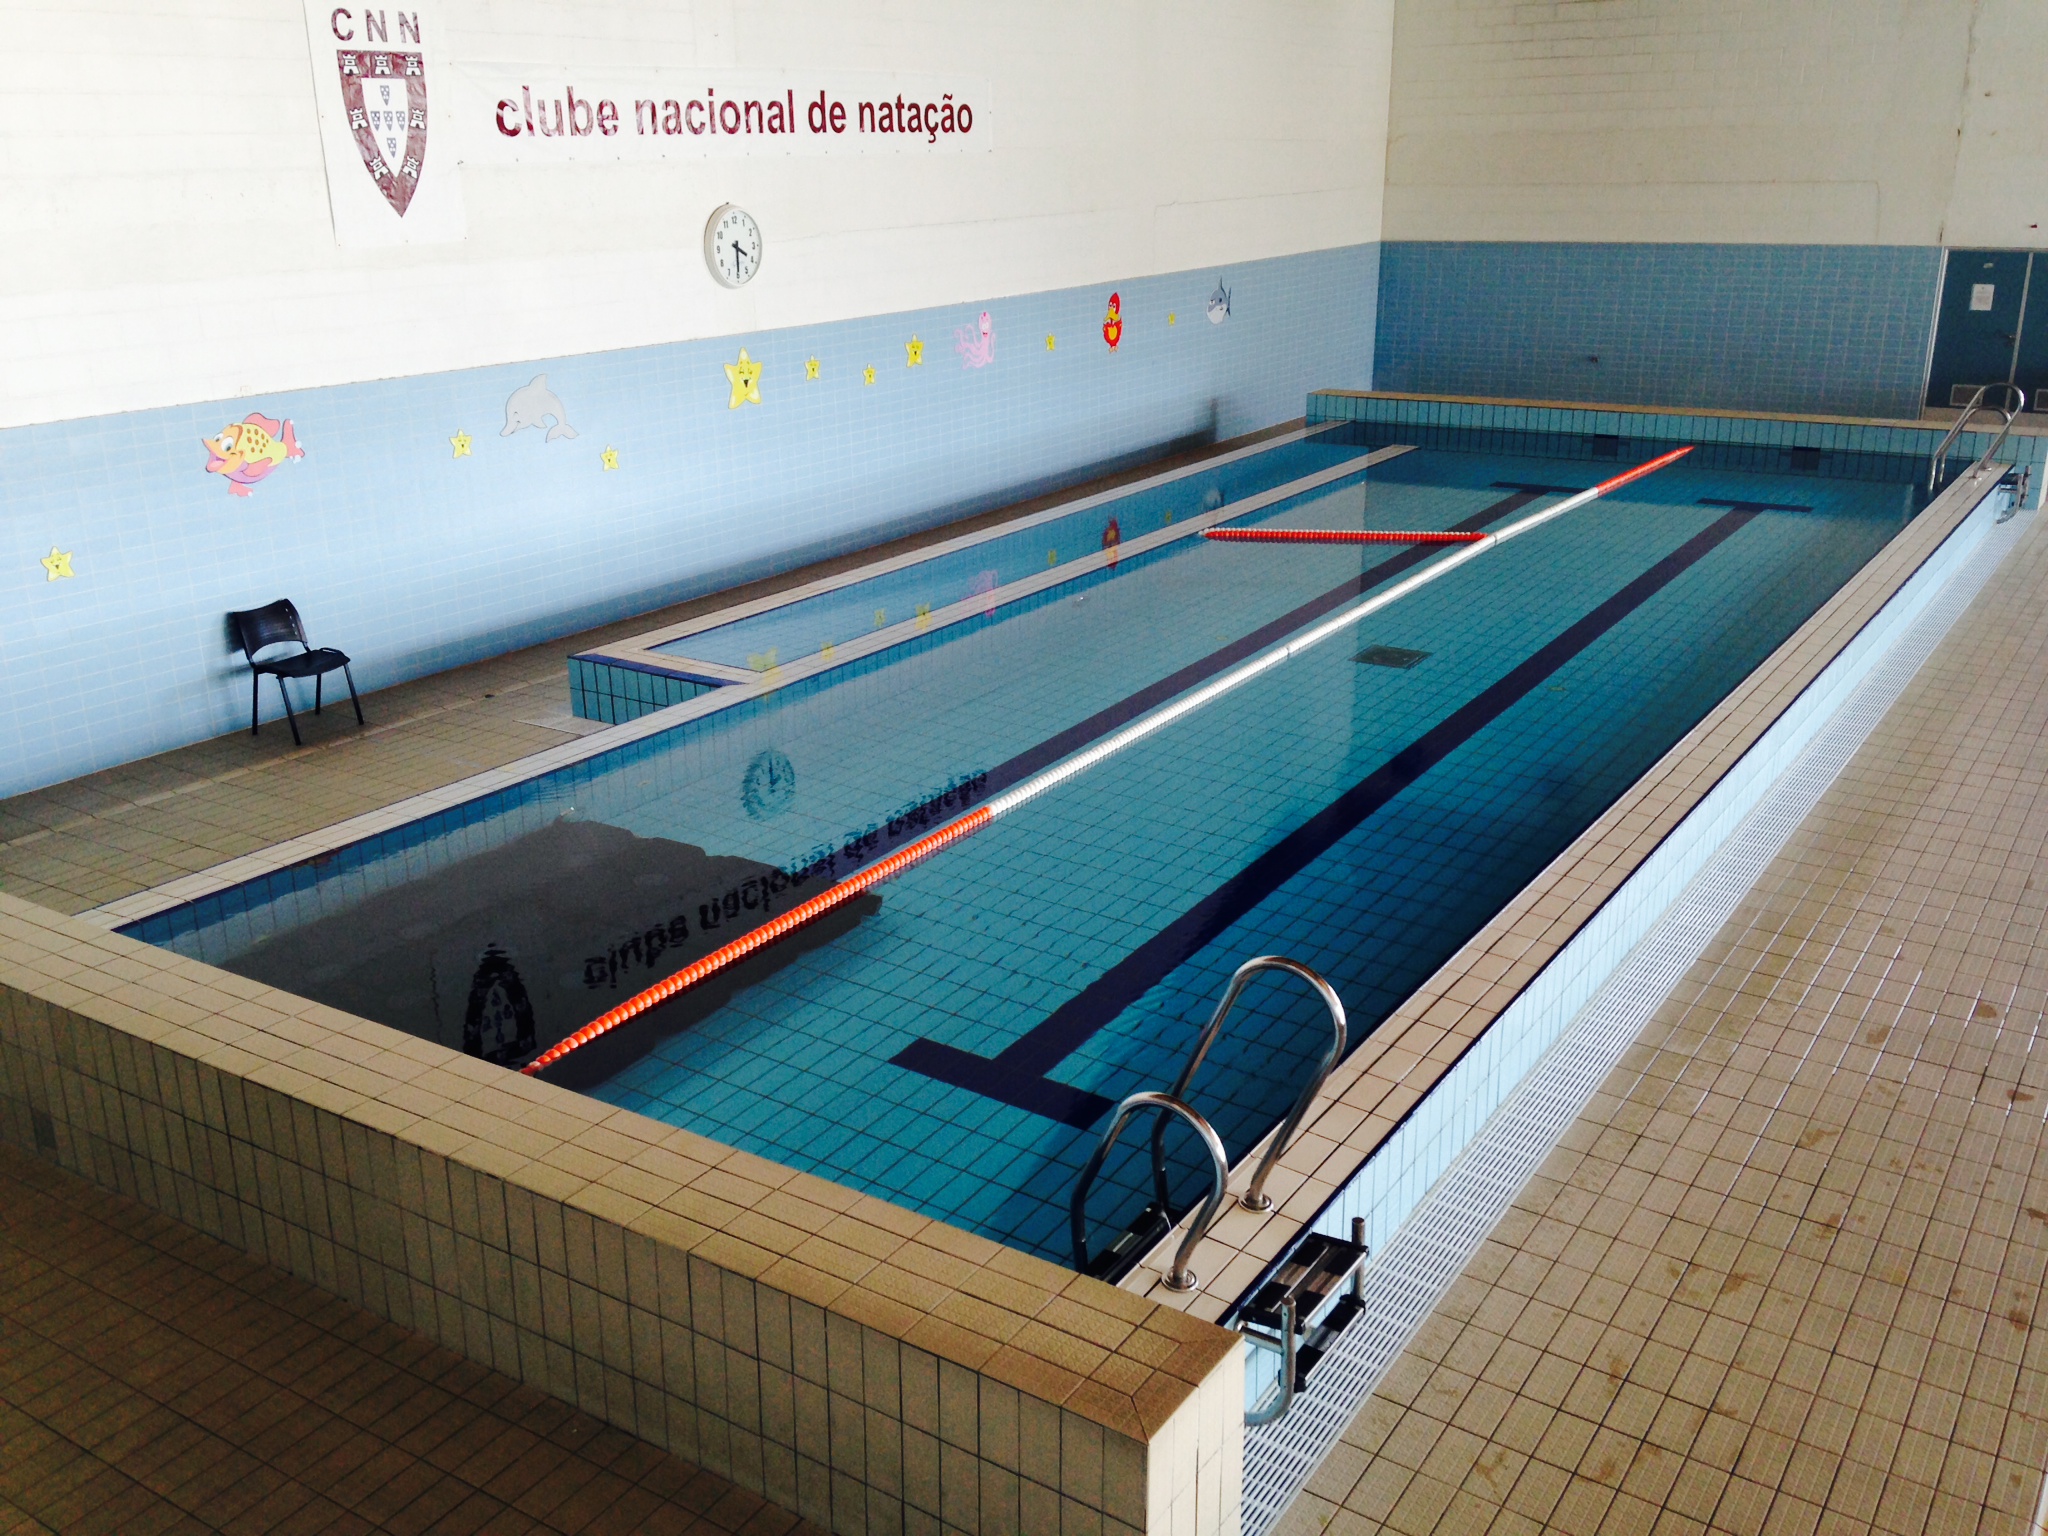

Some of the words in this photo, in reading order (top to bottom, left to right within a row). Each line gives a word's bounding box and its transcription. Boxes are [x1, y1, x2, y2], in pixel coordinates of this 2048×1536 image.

[496, 85, 619, 137] clube
[635, 88, 795, 135] nacional
[808, 90, 847, 133] de
[858, 93, 973, 143] natação
[731, 215, 738, 224] 12
[723, 220, 729, 229] 11
[717, 231, 723, 240] 10
